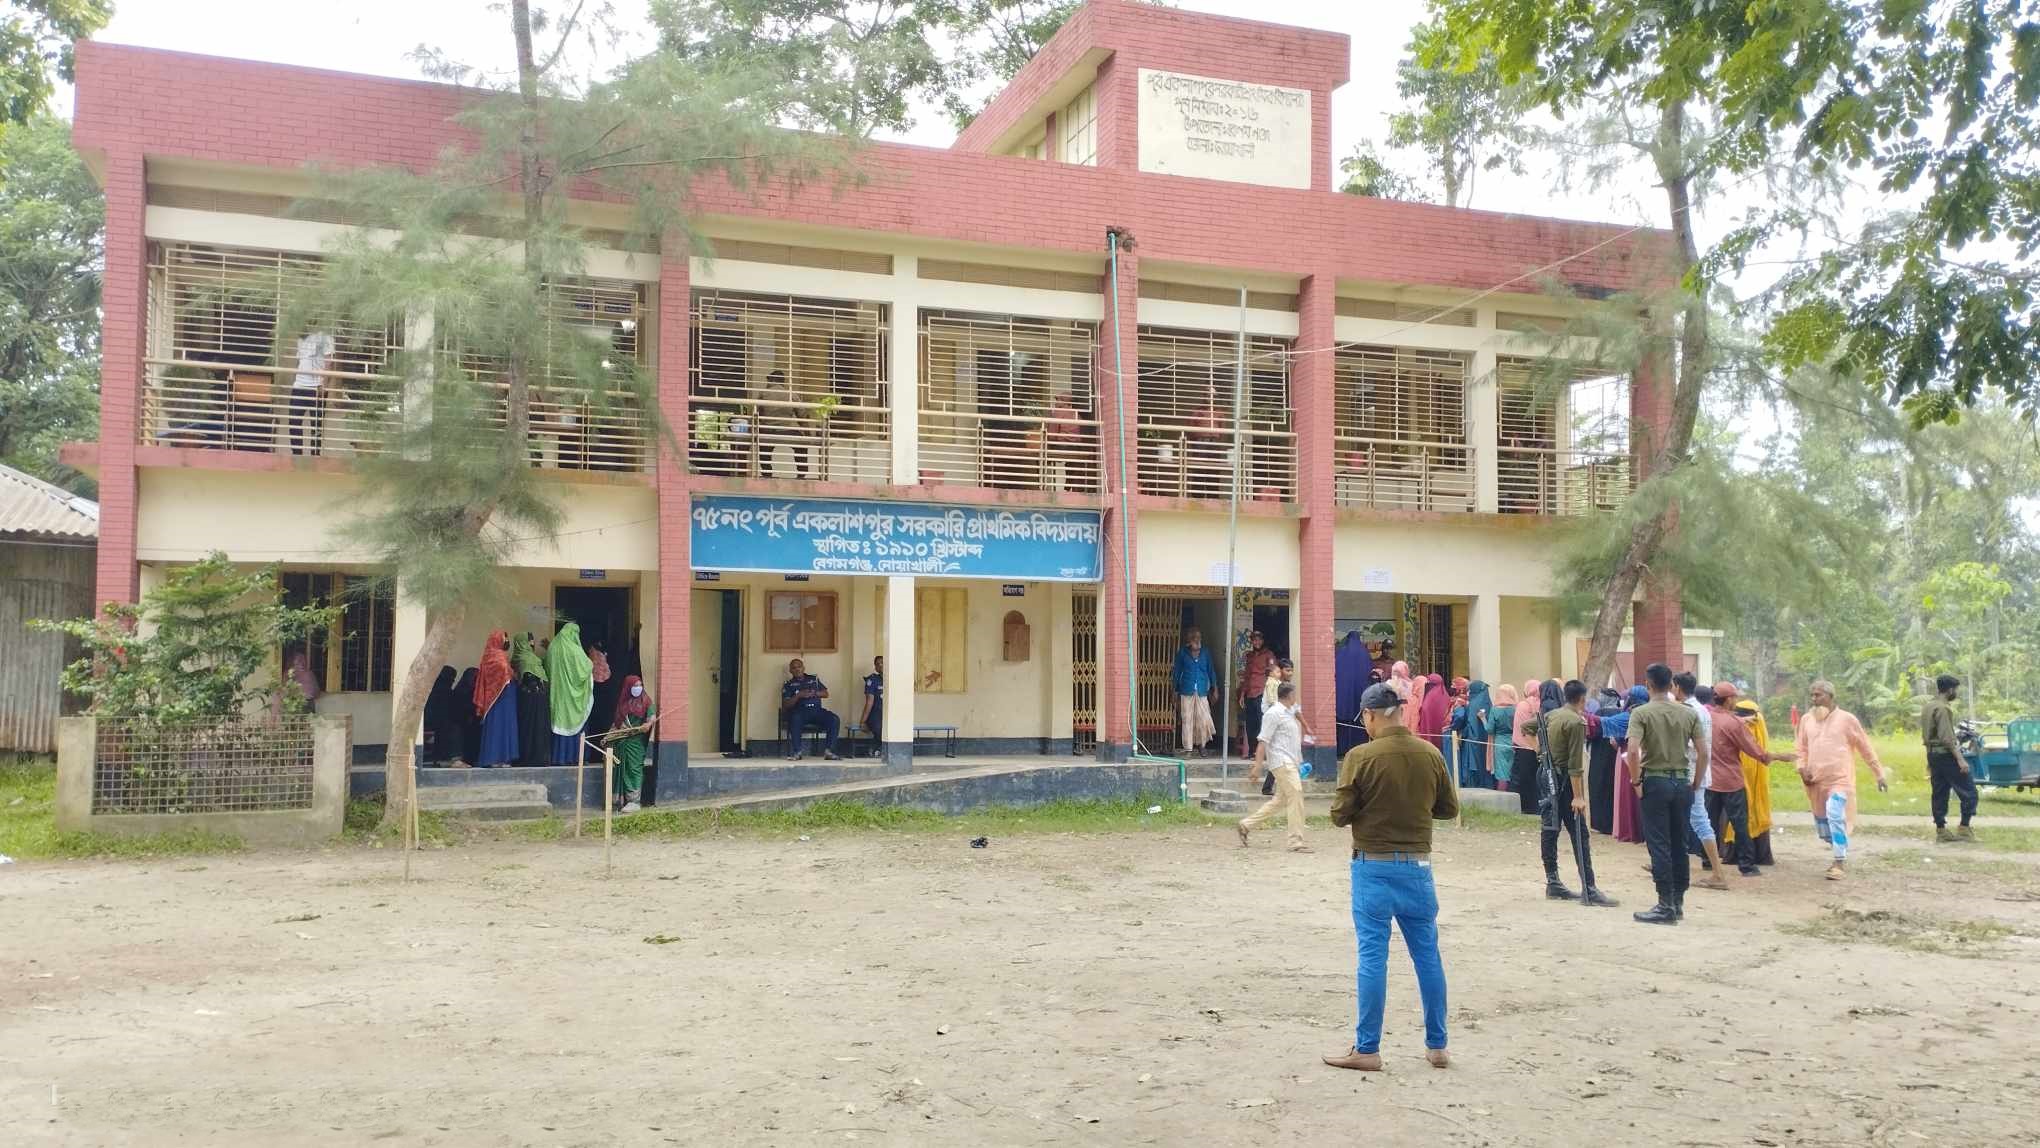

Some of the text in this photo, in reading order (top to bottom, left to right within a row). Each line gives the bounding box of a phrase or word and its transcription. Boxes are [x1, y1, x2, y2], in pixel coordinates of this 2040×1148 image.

[755, 504, 795, 539] পূর্ব
[897, 509, 965, 538] সরকারি
[966, 511, 1031, 541] প্রাথমিক
[1031, 512, 1100, 544] বিদ্যালয়
